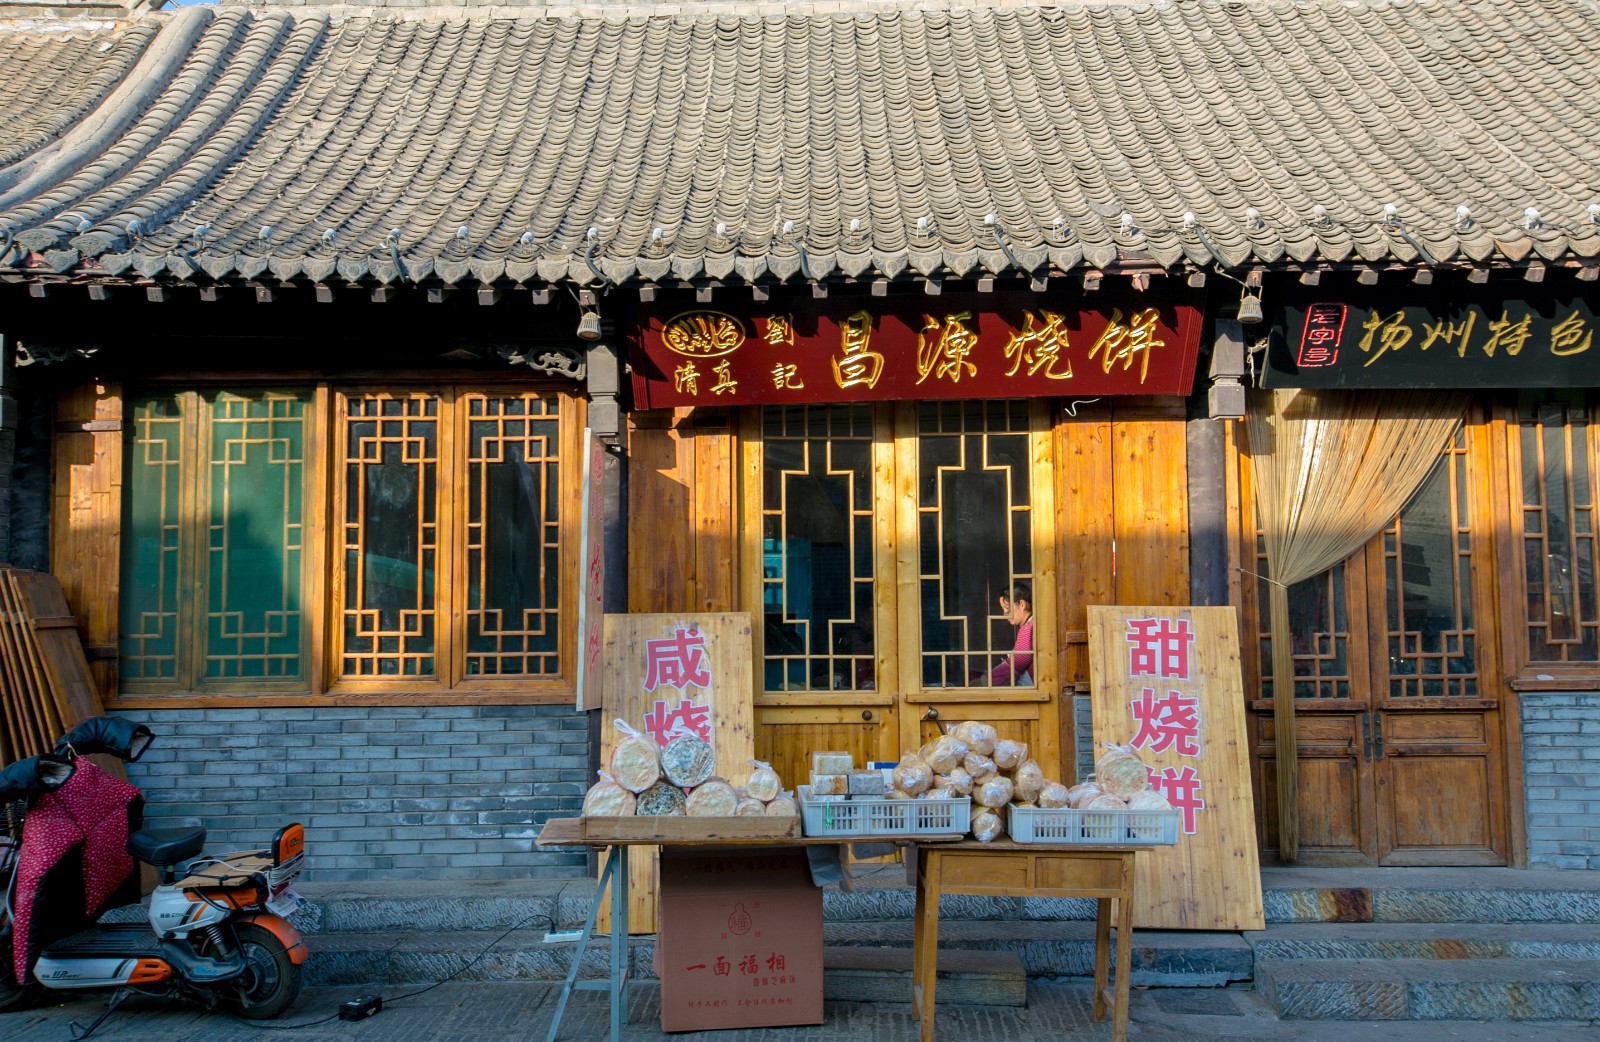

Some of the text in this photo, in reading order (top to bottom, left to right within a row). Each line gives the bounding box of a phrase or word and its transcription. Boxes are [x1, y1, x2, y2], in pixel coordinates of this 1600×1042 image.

[1303, 308, 1340, 362] 老字号
[674, 359, 738, 396] 清真
[643, 628, 711, 795] 咸烧
[686, 952, 785, 977] 一面福相
